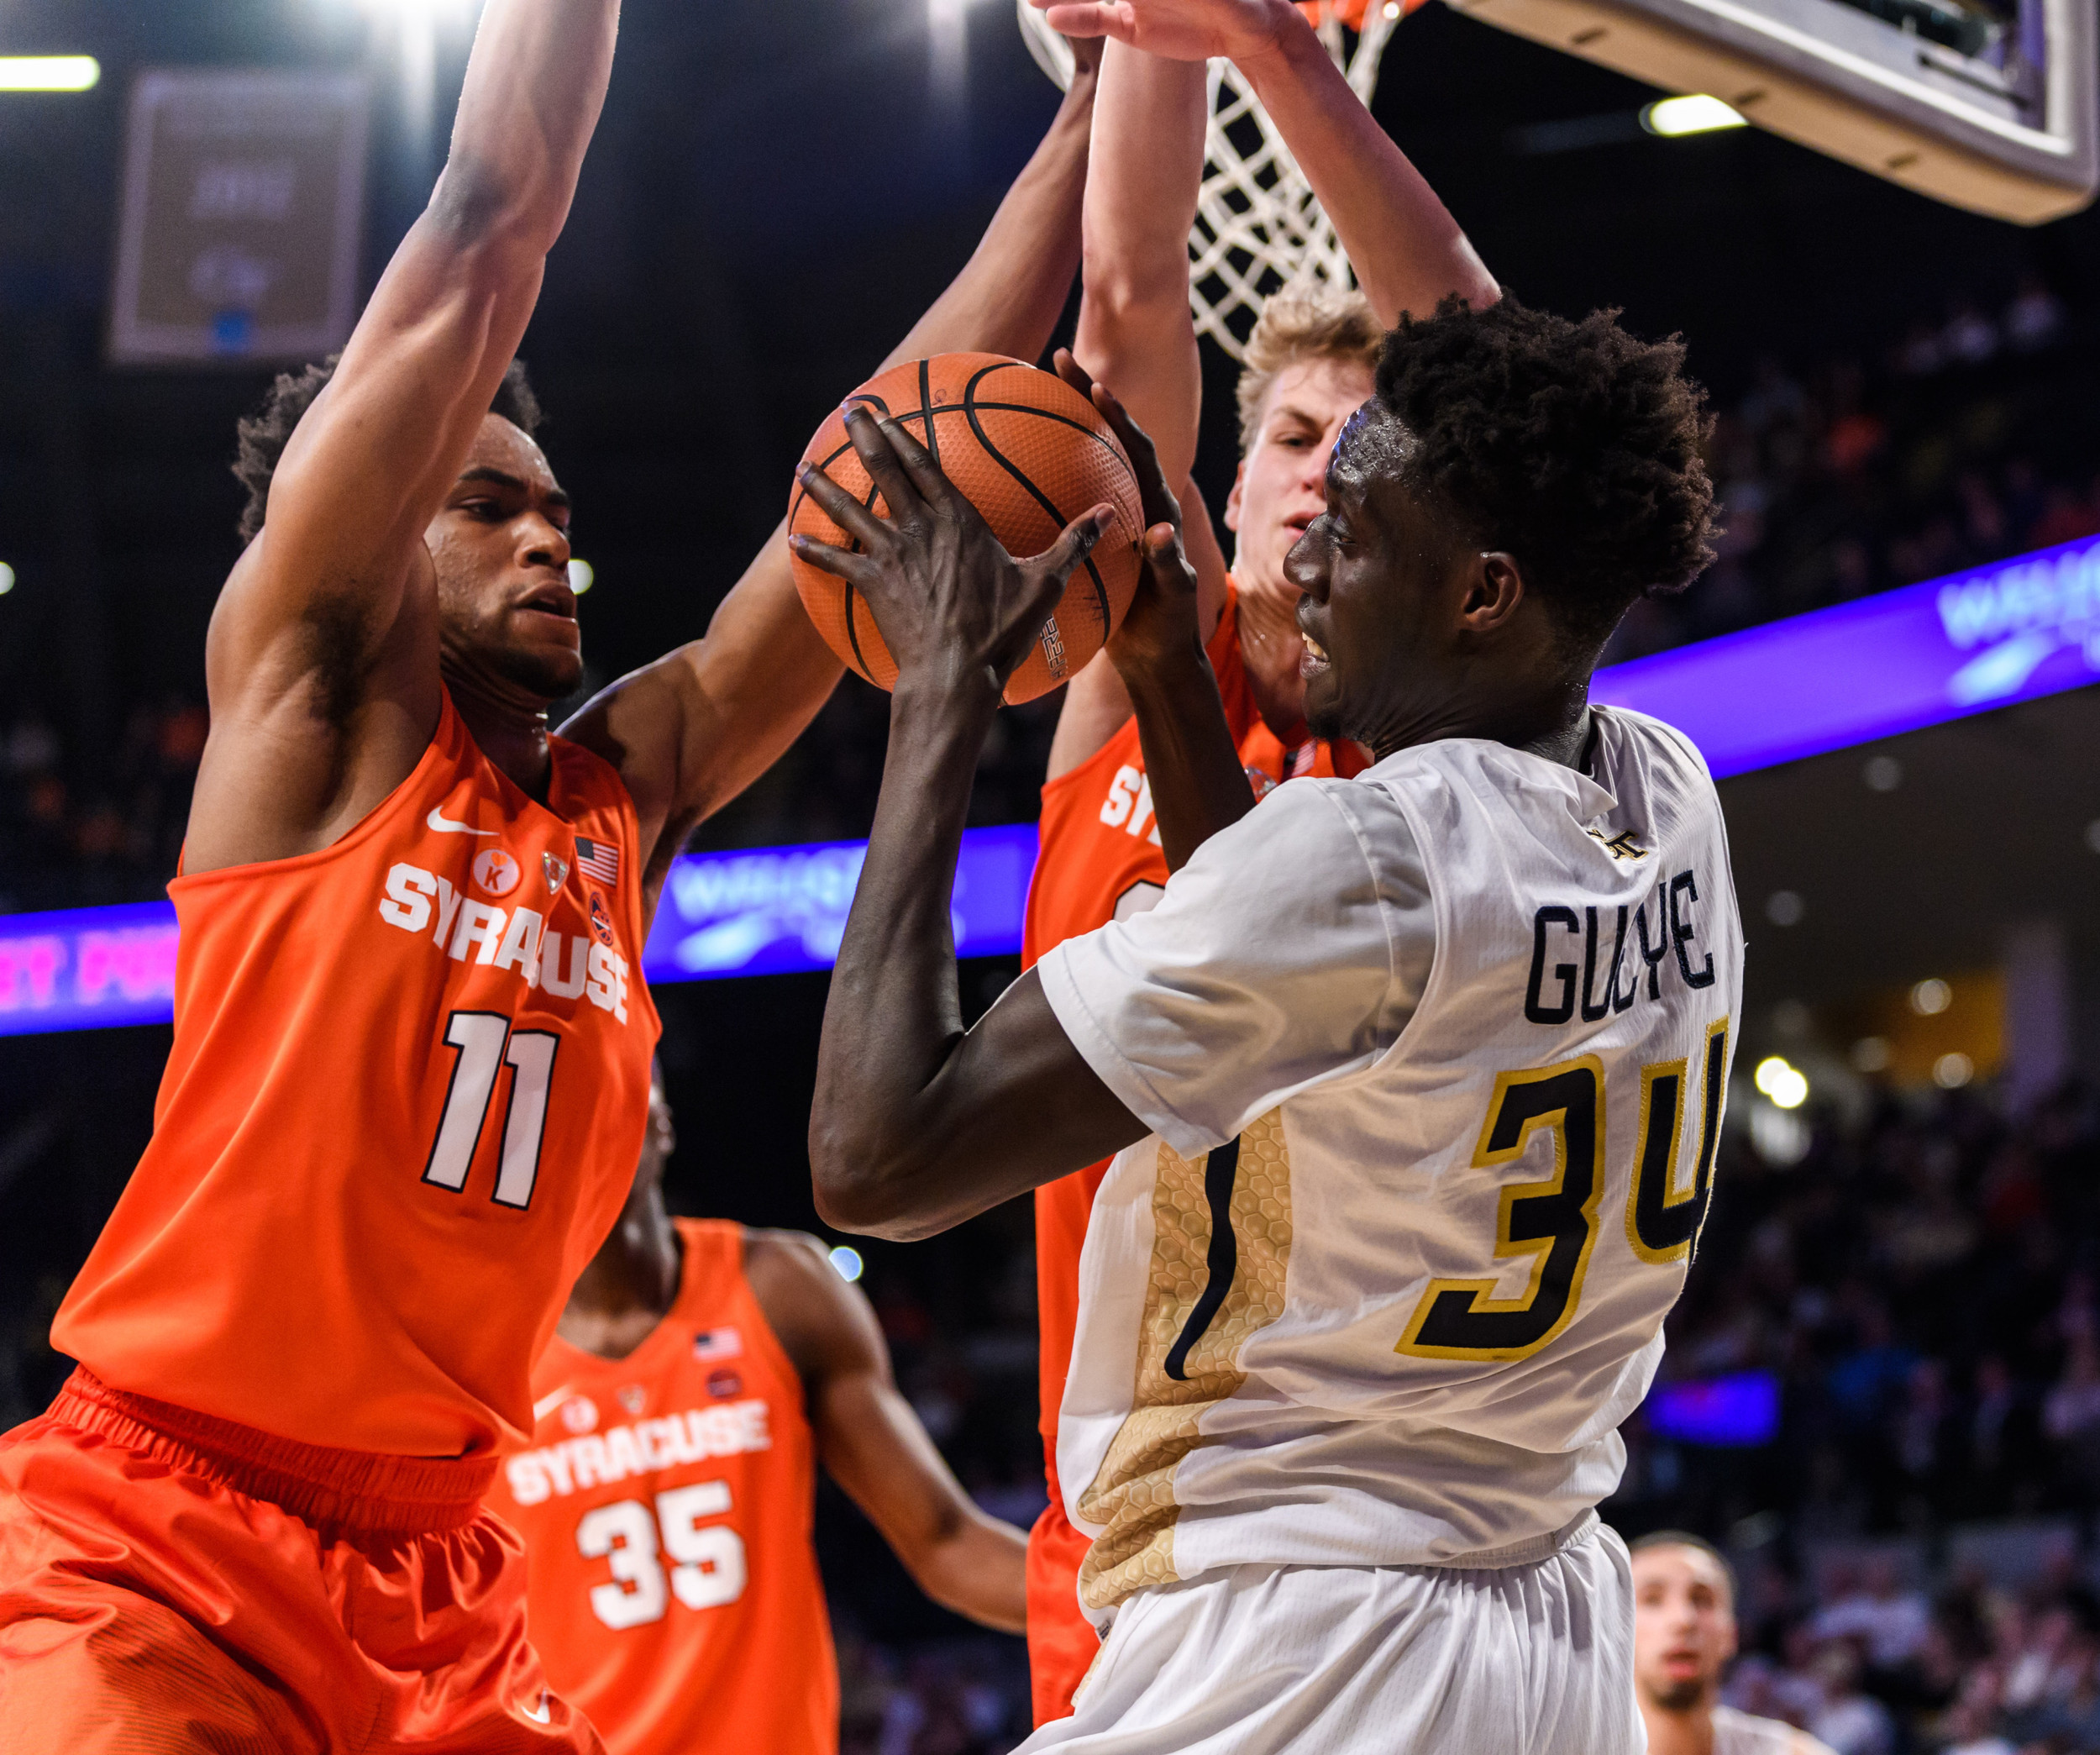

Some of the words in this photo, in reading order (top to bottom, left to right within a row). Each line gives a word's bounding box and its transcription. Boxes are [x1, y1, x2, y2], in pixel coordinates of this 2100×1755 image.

[379, 862, 629, 1027] SYRAUSE
[484, 865, 503, 891] K
[421, 1010, 561, 1211] 11
[1394, 1014, 1730, 1363] 34
[505, 1399, 773, 1506] SYRACUSE
[575, 1479, 750, 1631] 35
